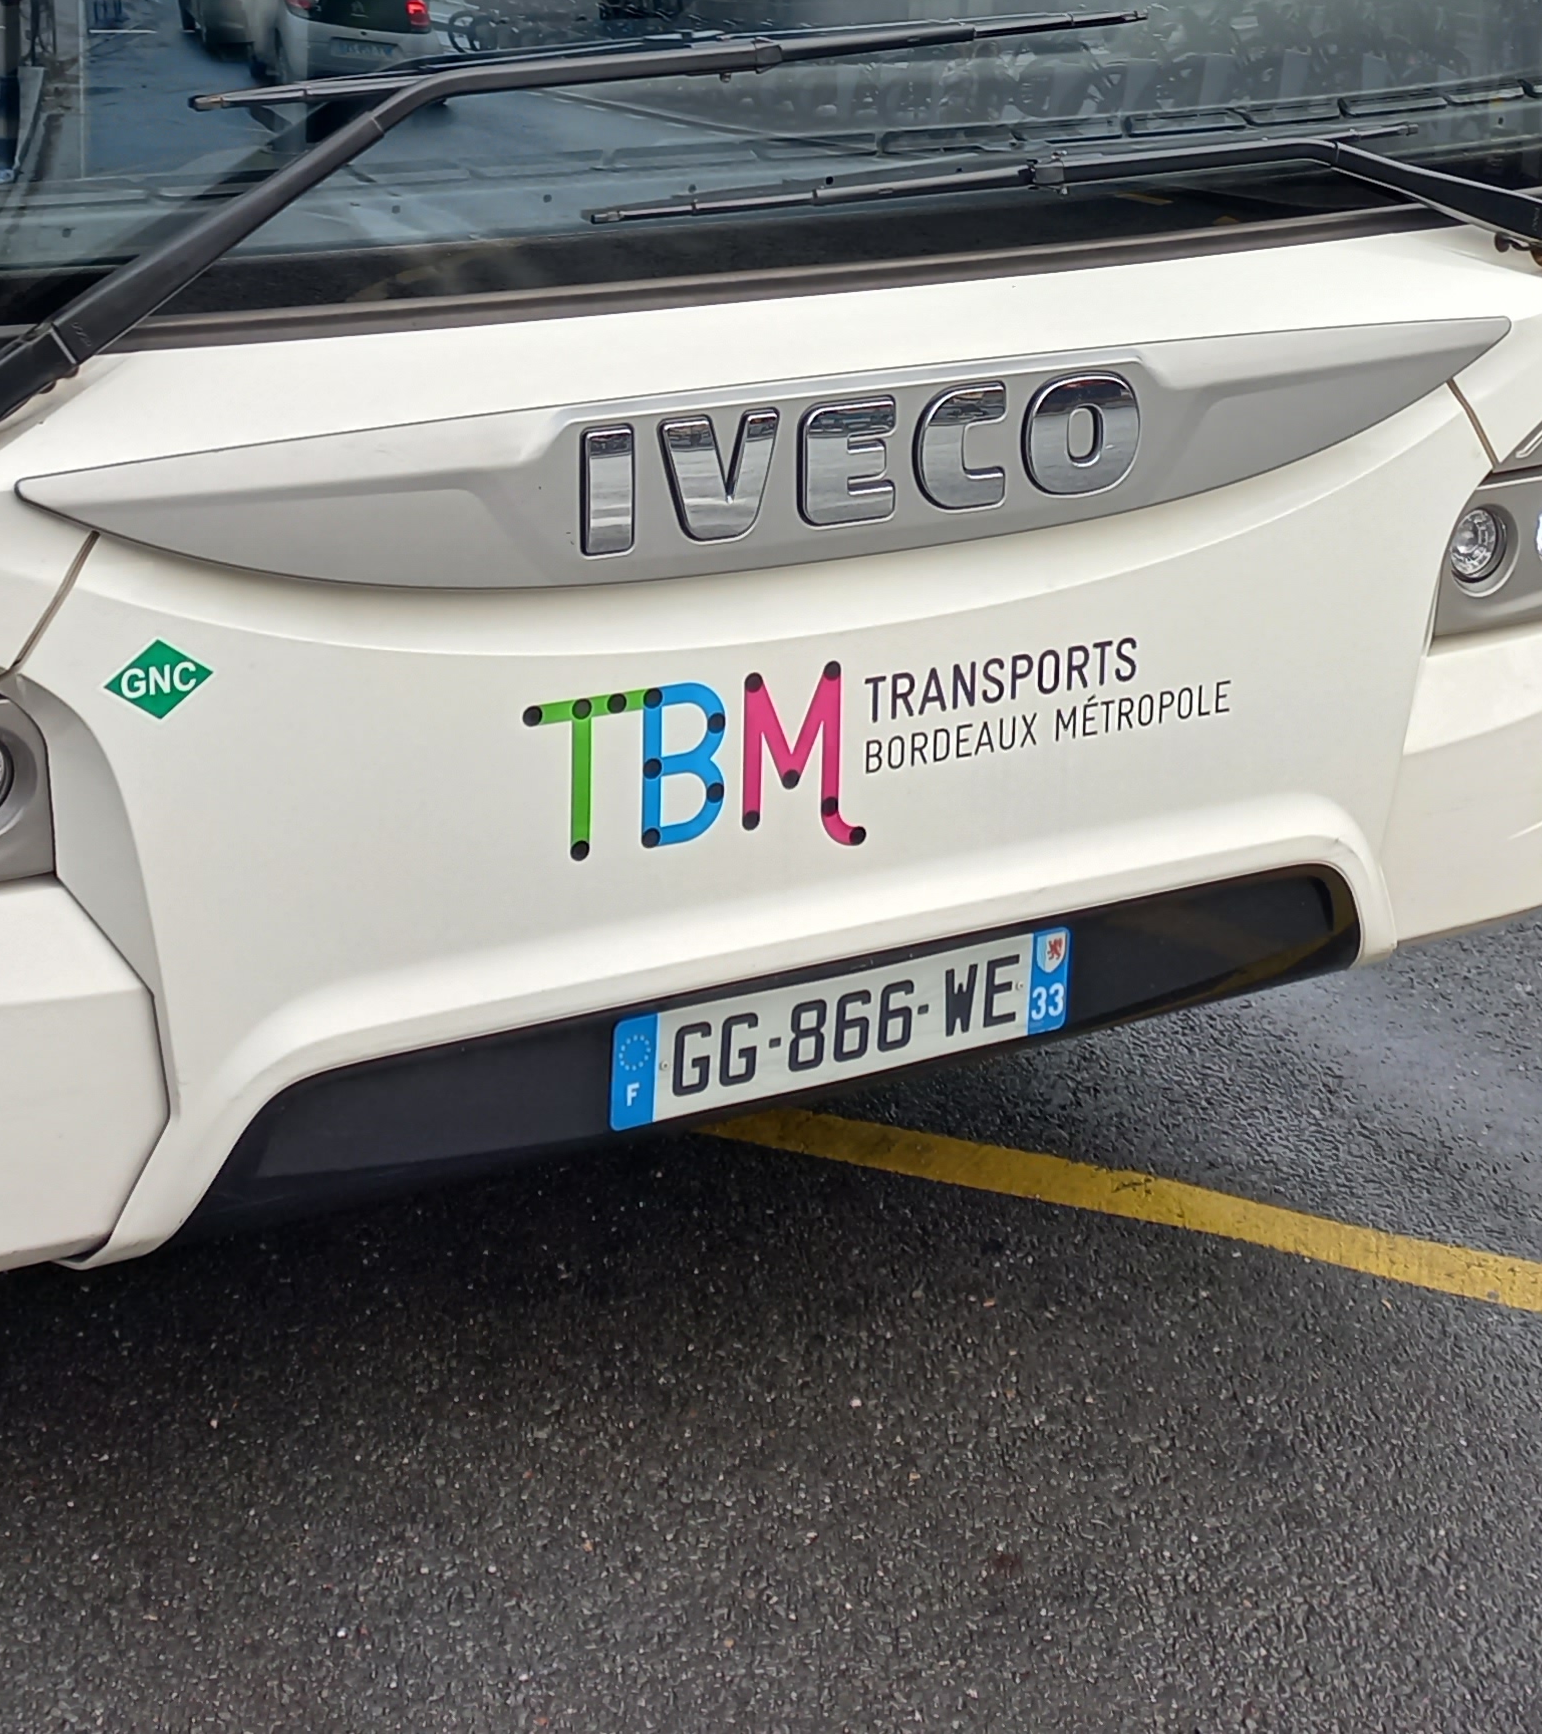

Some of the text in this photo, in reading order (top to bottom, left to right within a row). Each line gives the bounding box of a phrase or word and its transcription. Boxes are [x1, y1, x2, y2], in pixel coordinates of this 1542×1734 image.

[578, 369, 1142, 561] IVECO
[120, 660, 197, 700] GNC
[863, 636, 1139, 724] TRANSPORTS
[521, 659, 866, 862] TBM
[864, 679, 1233, 775] BORDEAUX MÉTROPOLE
[671, 953, 1022, 1097] GG-866-WE
[1031, 982, 1065, 1022] 33
[625, 1081, 640, 1107] F
